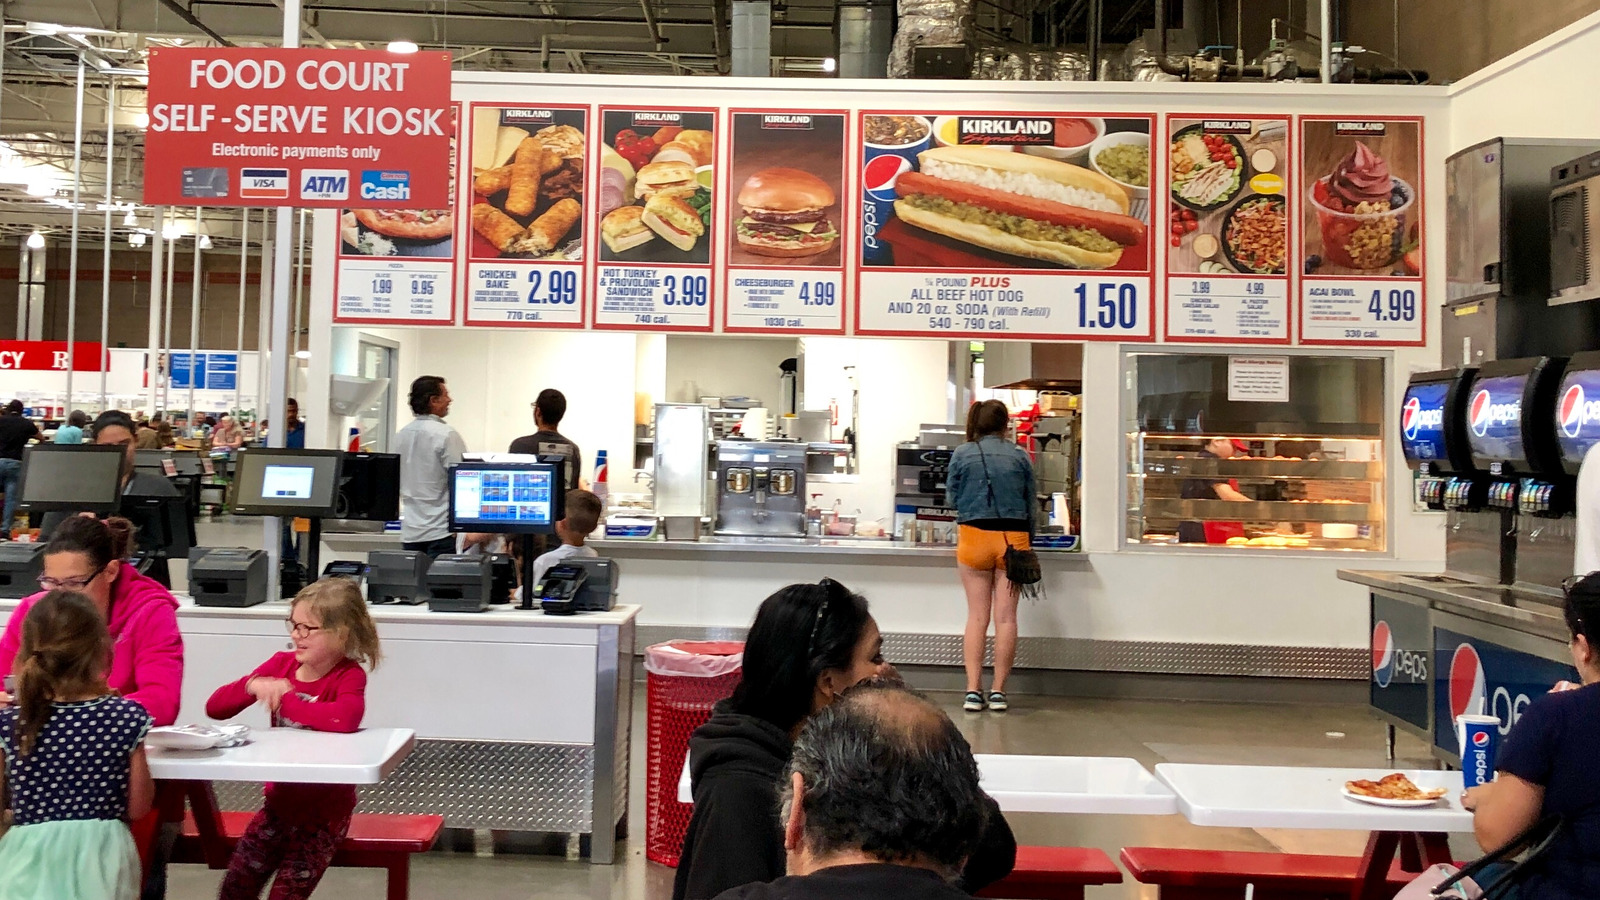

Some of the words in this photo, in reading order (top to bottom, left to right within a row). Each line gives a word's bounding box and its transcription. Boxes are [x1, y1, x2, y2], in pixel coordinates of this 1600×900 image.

[190, 59, 286, 89] FOOD
[297, 60, 409, 91] COURT
[506, 109, 552, 118] KIRKLAND
[635, 113, 680, 122] KIRKLAND
[764, 115, 810, 124] KIRKLAND
[343, 107, 445, 136] KIOSK
[962, 119, 1053, 135] KIRKLAND
[961, 133, 1052, 145] Signature
[212, 143, 279, 157] Electronic
[282, 144, 348, 159] payments
[352, 145, 381, 161] only
[253, 179, 276, 188] VISA
[303, 176, 346, 193] ATM
[360, 182, 410, 200] Cash
[864, 200, 880, 248] pepsi
[479, 269, 516, 279] CHICKEN
[603, 268, 620, 277] HOT
[623, 269, 657, 278] TURKEY
[372, 279, 392, 294] 1.99
[411, 280, 434, 295] 9.95
[485, 280, 509, 288] BAKE
[527, 270, 576, 304] 2.99
[600, 277, 606, 286] &
[609, 278, 660, 287] PROVOLONE
[735, 278, 794, 287] CHEESEBURGER
[936, 278, 967, 288] POUND
[970, 277, 1011, 288] PLUS
[1192, 281, 1210, 293] 3.99
[1246, 283, 1264, 294] 4.99
[606, 287, 653, 296] SANDWICH
[663, 275, 707, 306] 3.99
[798, 281, 835, 306] 4.99
[910, 289, 933, 301] ALL
[937, 289, 966, 301] BEEF
[969, 290, 994, 302] HOT
[998, 290, 1024, 302] DOG
[1309, 288, 1329, 296] ACAI
[887, 302, 913, 314] AND
[916, 302, 932, 315] 20
[935, 305, 952, 315] oz.
[956, 303, 989, 316] SODA
[992, 306, 1018, 317] (With
[1020, 306, 1051, 319] Refill)
[1073, 282, 1137, 329] 1.50
[1368, 290, 1415, 321] 4.99
[506, 311, 522, 320] 770
[525, 312, 542, 320] cal.
[635, 315, 651, 323] 740
[653, 315, 670, 323] cal.
[764, 317, 785, 326] 1030
[787, 318, 804, 327] cal.
[928, 317, 952, 329] 540
[963, 318, 985, 330] 790
[988, 318, 1010, 331] cal.
[0, 351, 25, 368] CY
[1418, 406, 1444, 429] pepsi
[1489, 400, 1521, 425] pepsi
[1474, 750, 1487, 784] pepsi
